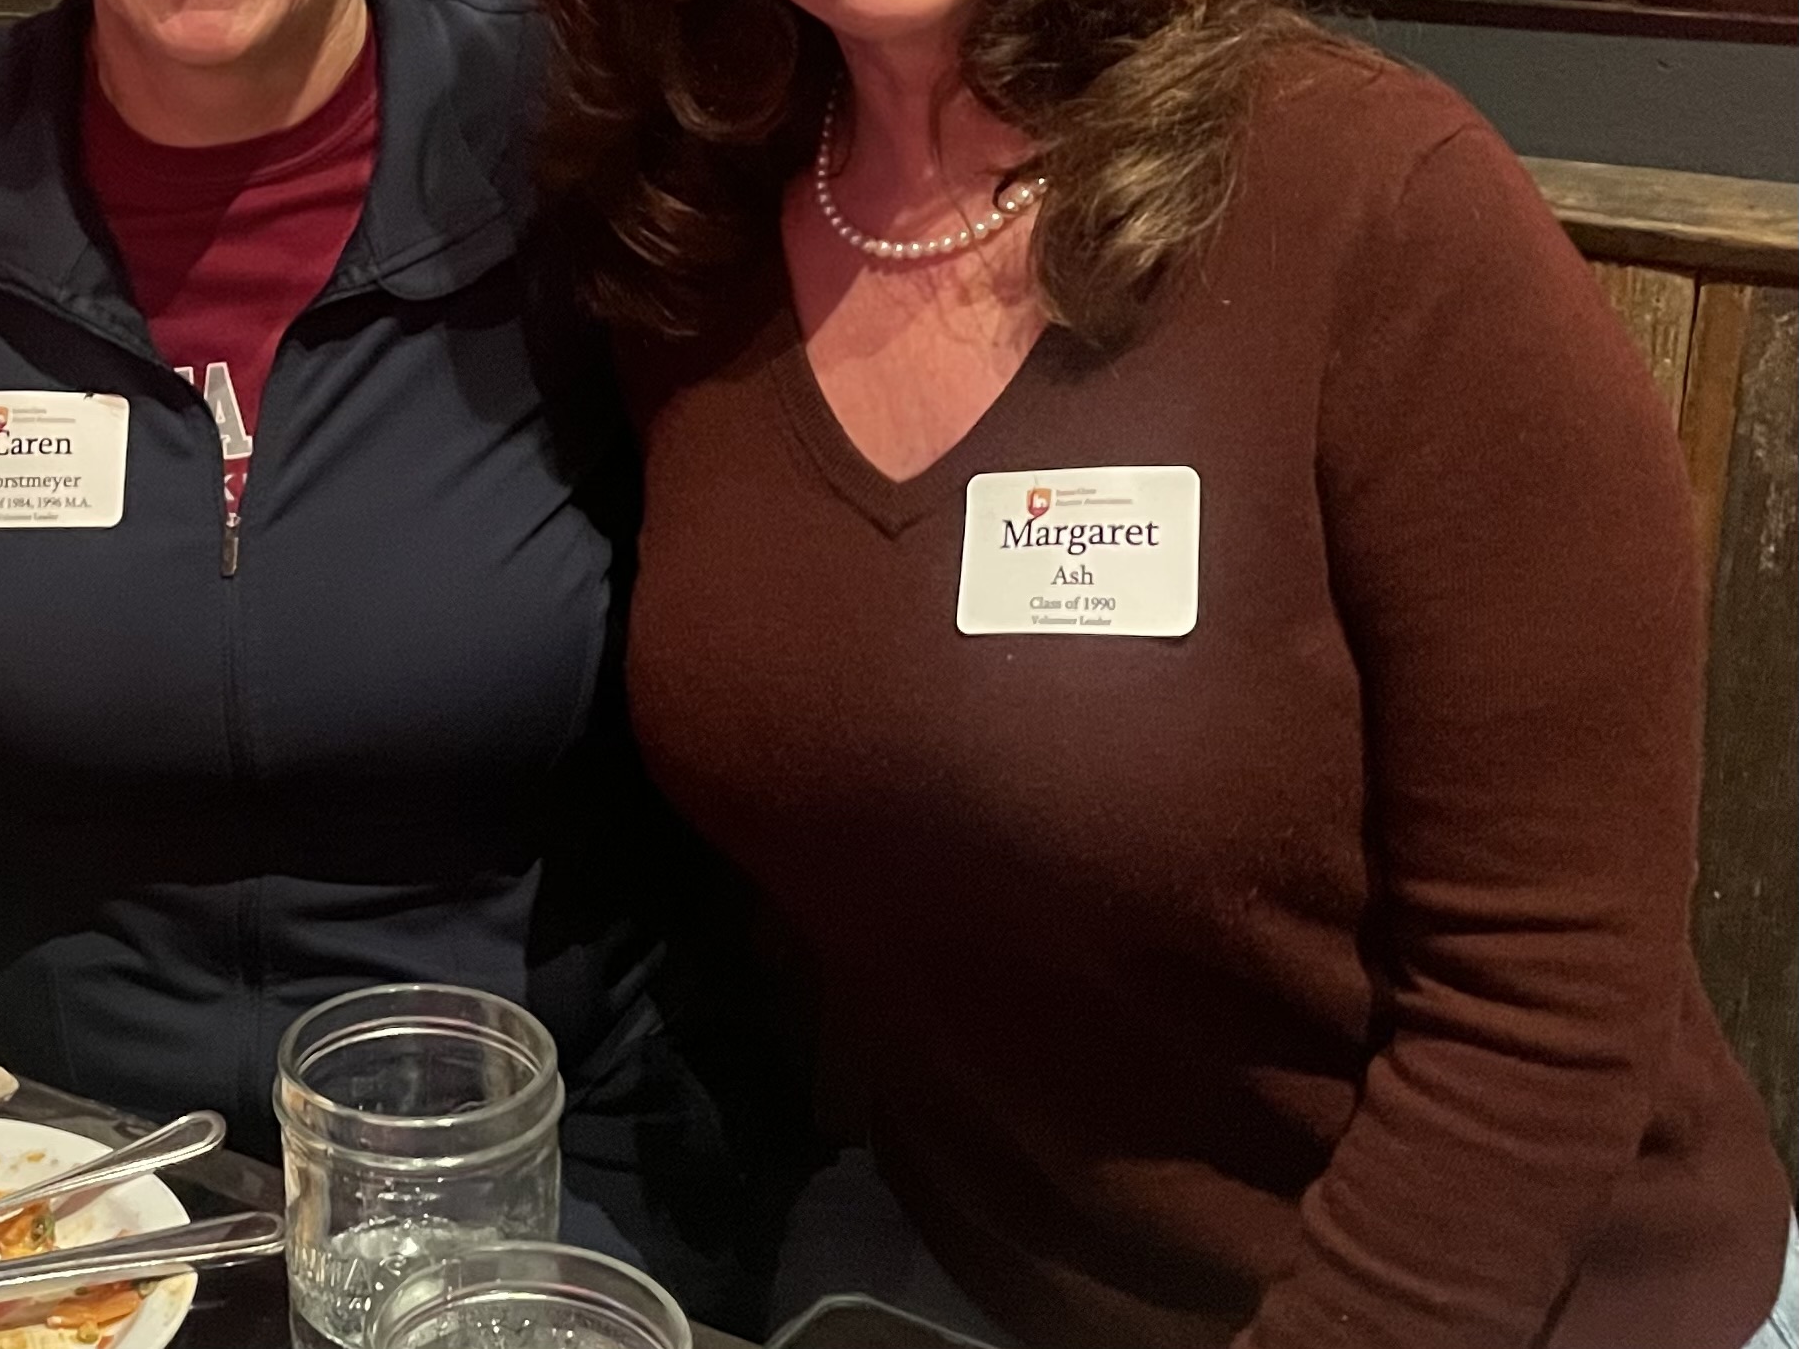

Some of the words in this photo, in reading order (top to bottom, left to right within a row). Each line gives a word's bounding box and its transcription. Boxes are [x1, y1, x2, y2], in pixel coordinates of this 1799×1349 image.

[1000, 518, 1160, 556] Margaret
[1051, 564, 1094, 585] Ash
[1029, 596, 1061, 610] Class
[1065, 596, 1082, 610] of
[1084, 597, 1116, 611] 1990
